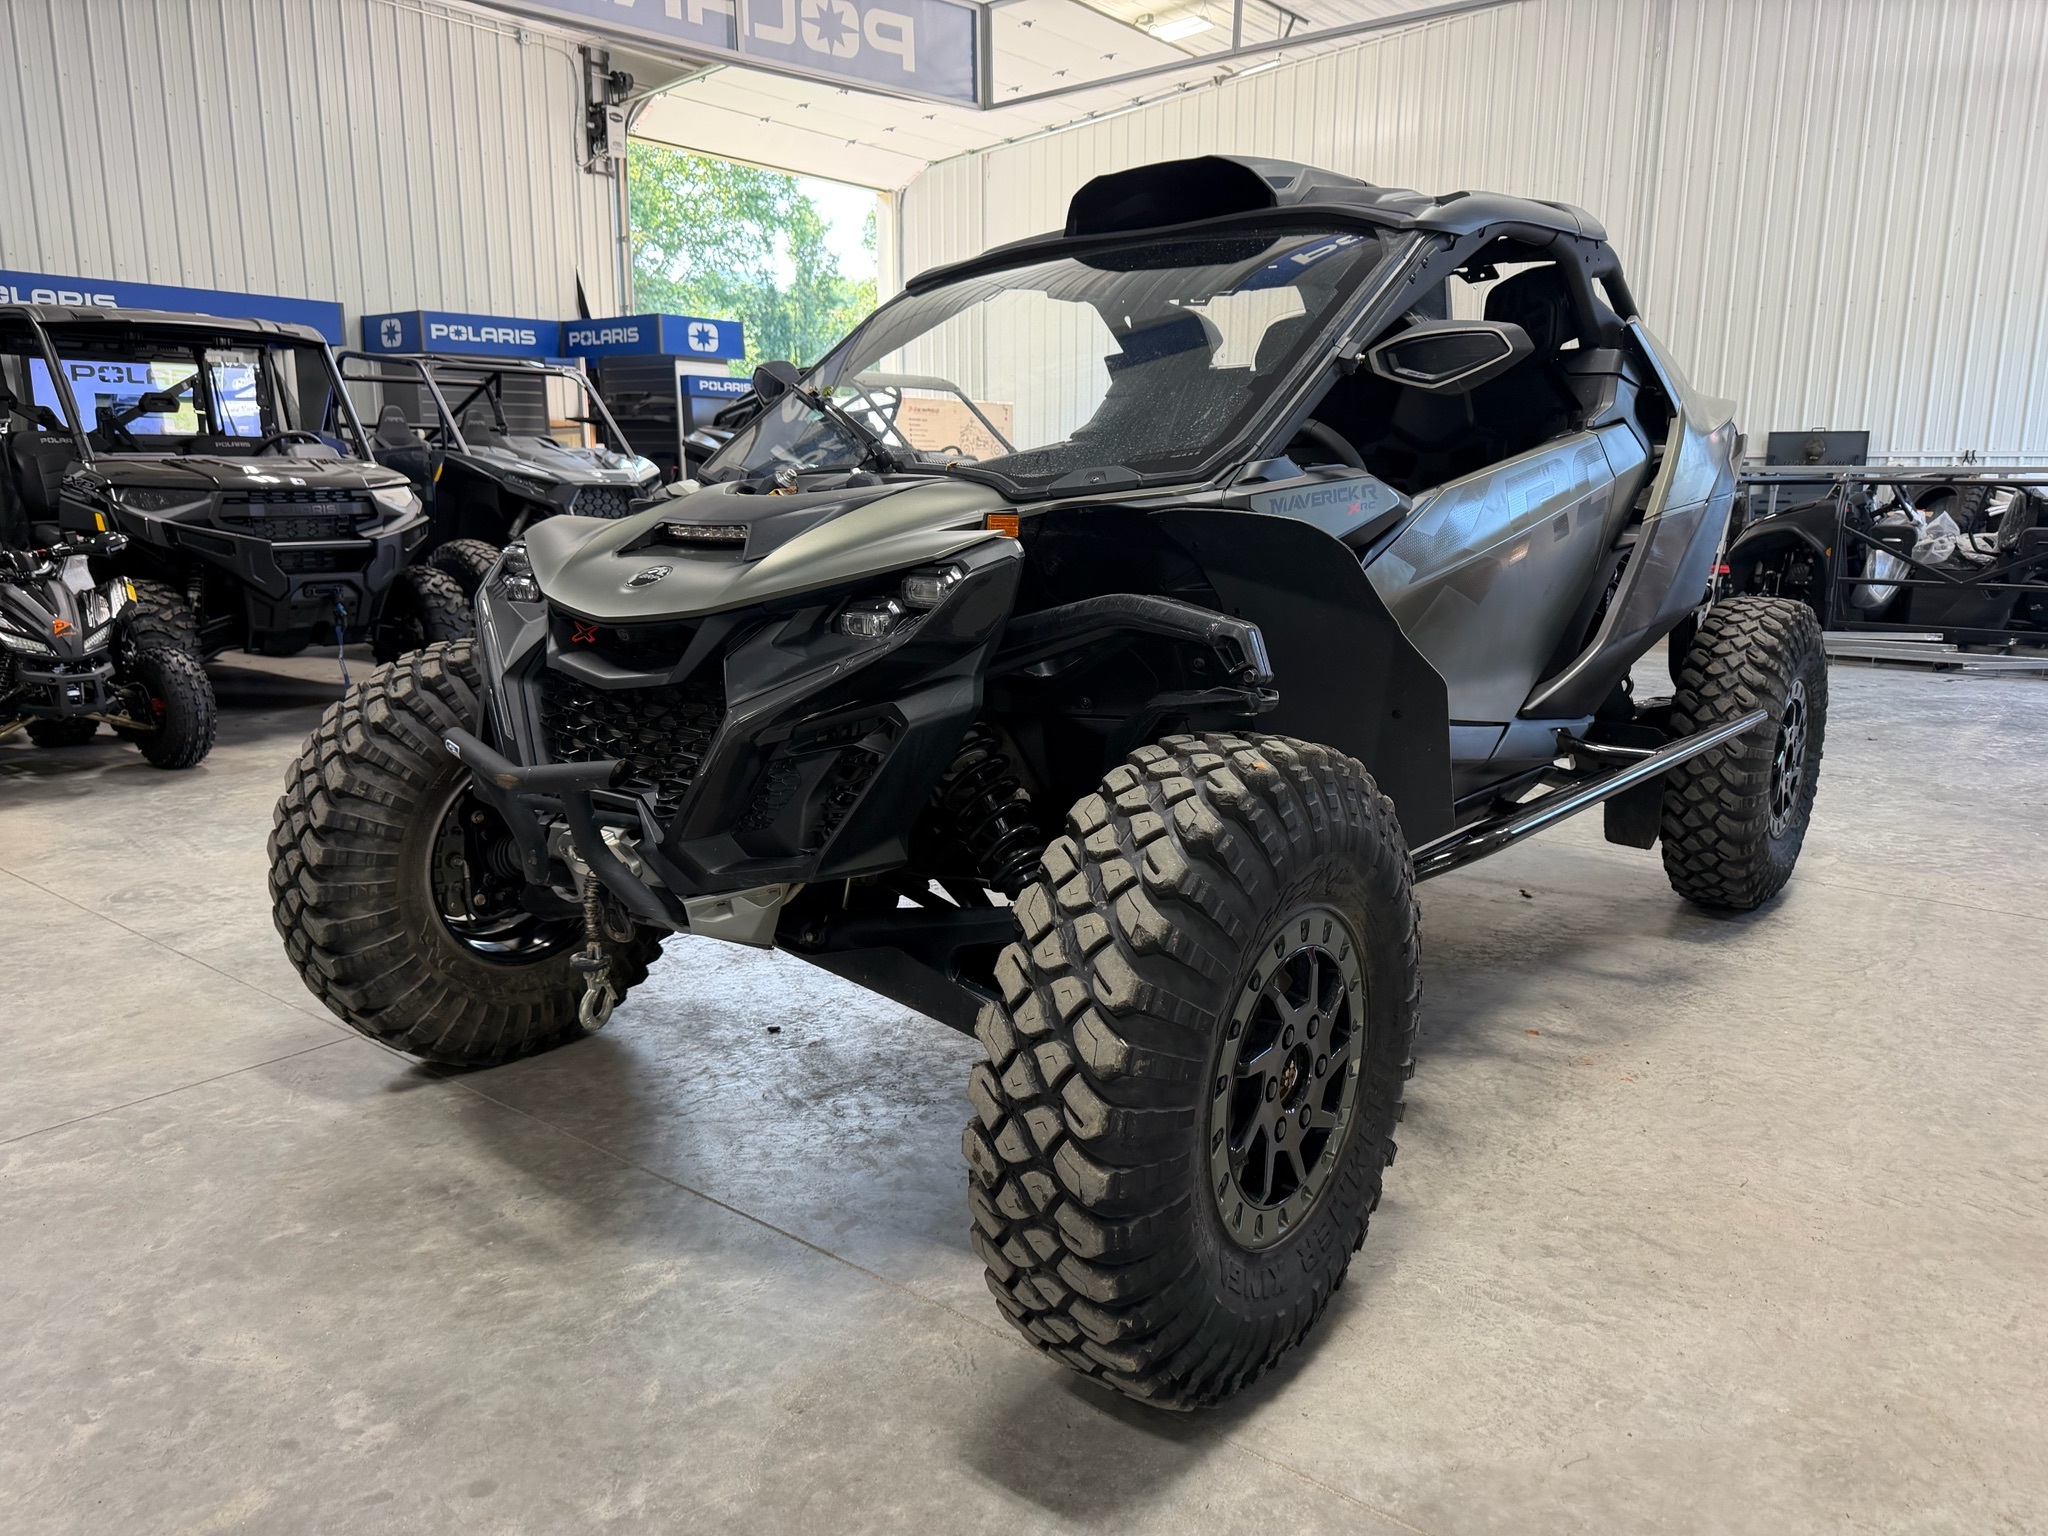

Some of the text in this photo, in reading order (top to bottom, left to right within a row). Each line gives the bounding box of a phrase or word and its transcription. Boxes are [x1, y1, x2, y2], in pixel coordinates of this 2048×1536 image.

[430, 322, 537, 347] POLARIS
[568, 326, 640, 347] POLARIS
[699, 380, 753, 393] POLARIS
[1269, 485, 1360, 514] MAVERICK
